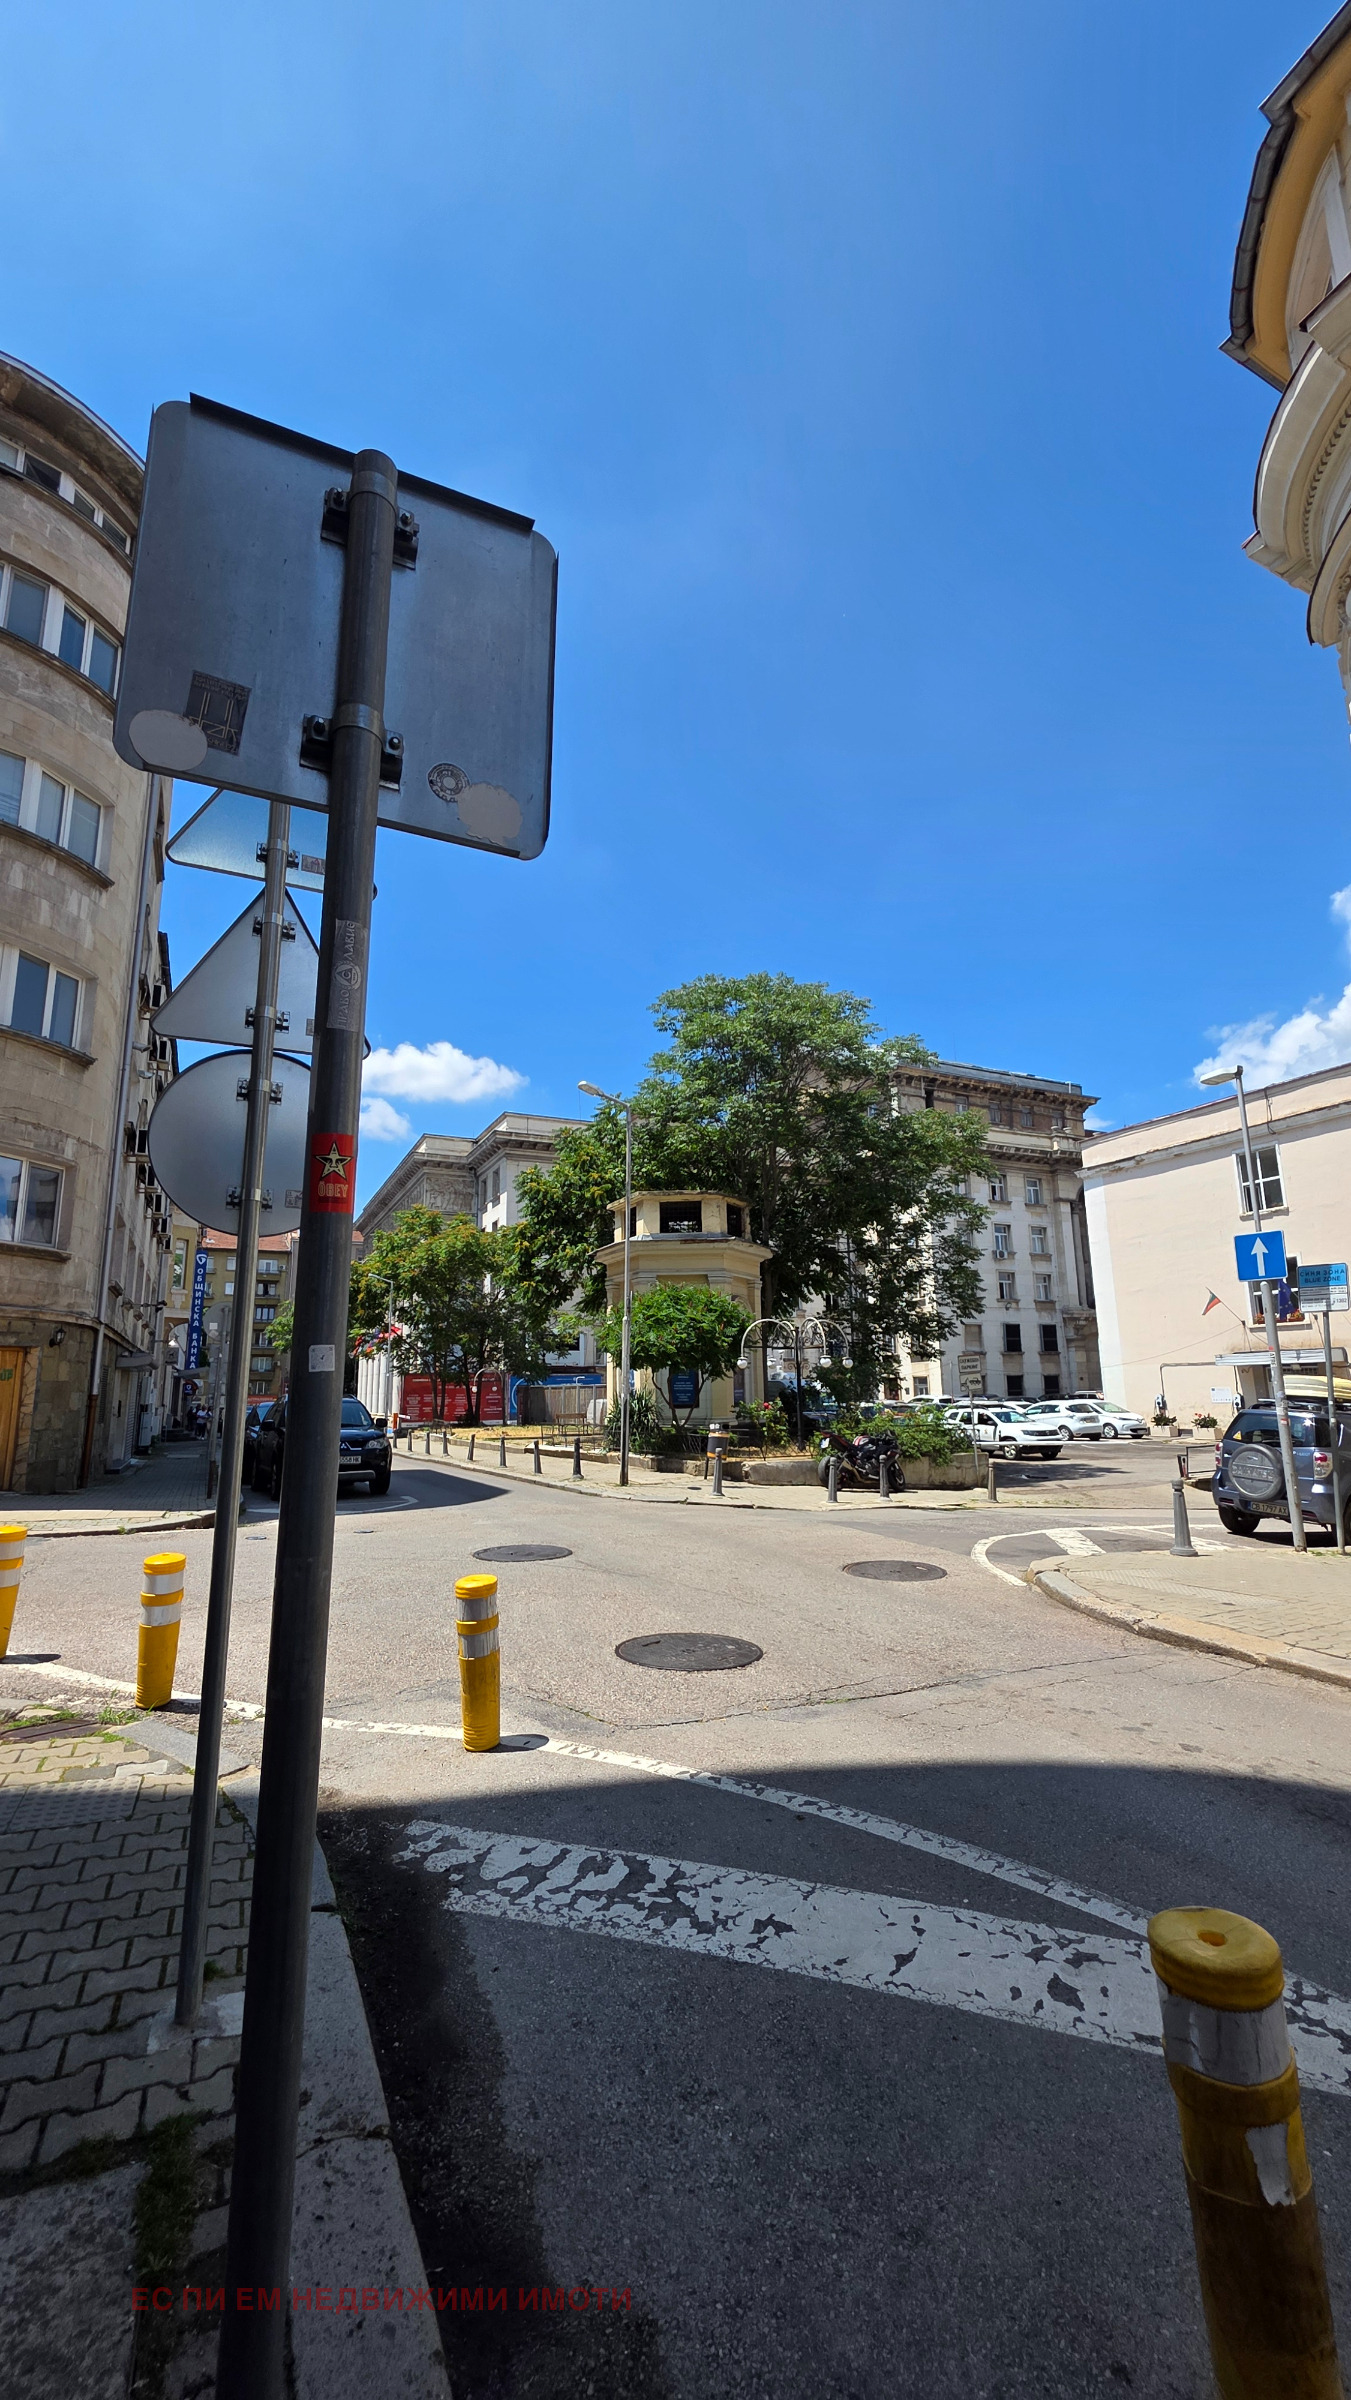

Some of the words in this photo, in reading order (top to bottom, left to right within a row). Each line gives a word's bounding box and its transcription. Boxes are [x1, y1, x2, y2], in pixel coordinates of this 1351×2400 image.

[1300, 1270, 1321, 1278] СИНЯ
[1323, 1268, 1345, 1277] ЗОНА
[1323, 1275, 1341, 1283] ZONE
[193, 1268, 204, 1327] ОБЩИНСКА
[189, 1332, 198, 1369] БАНКА
